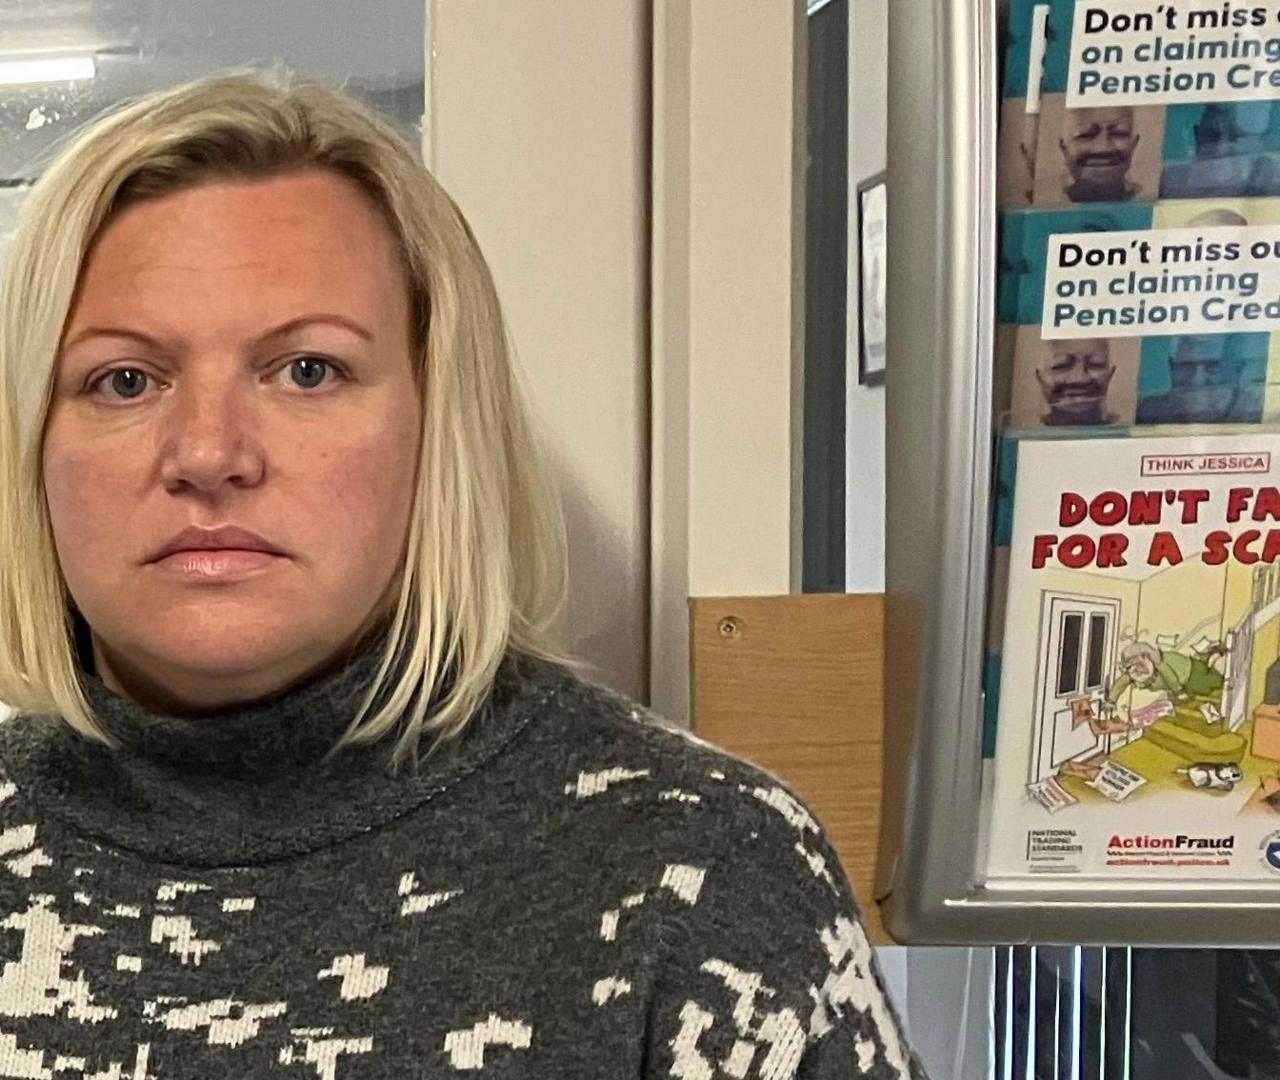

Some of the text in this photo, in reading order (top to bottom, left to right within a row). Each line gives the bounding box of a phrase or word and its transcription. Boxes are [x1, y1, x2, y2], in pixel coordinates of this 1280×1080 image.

[1085, 2, 1266, 33] Don't miss
[1082, 33, 1280, 64] on claiming
[1078, 66, 1215, 95] Pension
[1059, 240, 1151, 267] Don't
[1161, 237, 1240, 263] miss
[1056, 268, 1259, 298] on claiming
[1054, 300, 1189, 328] Pension
[1147, 456, 1265, 472] THINK JESSICA
[1059, 489, 1210, 527] DON'T
[1032, 533, 1129, 569] FOR
[1147, 531, 1183, 566] A
[1108, 835, 1234, 849] ActionFraud
